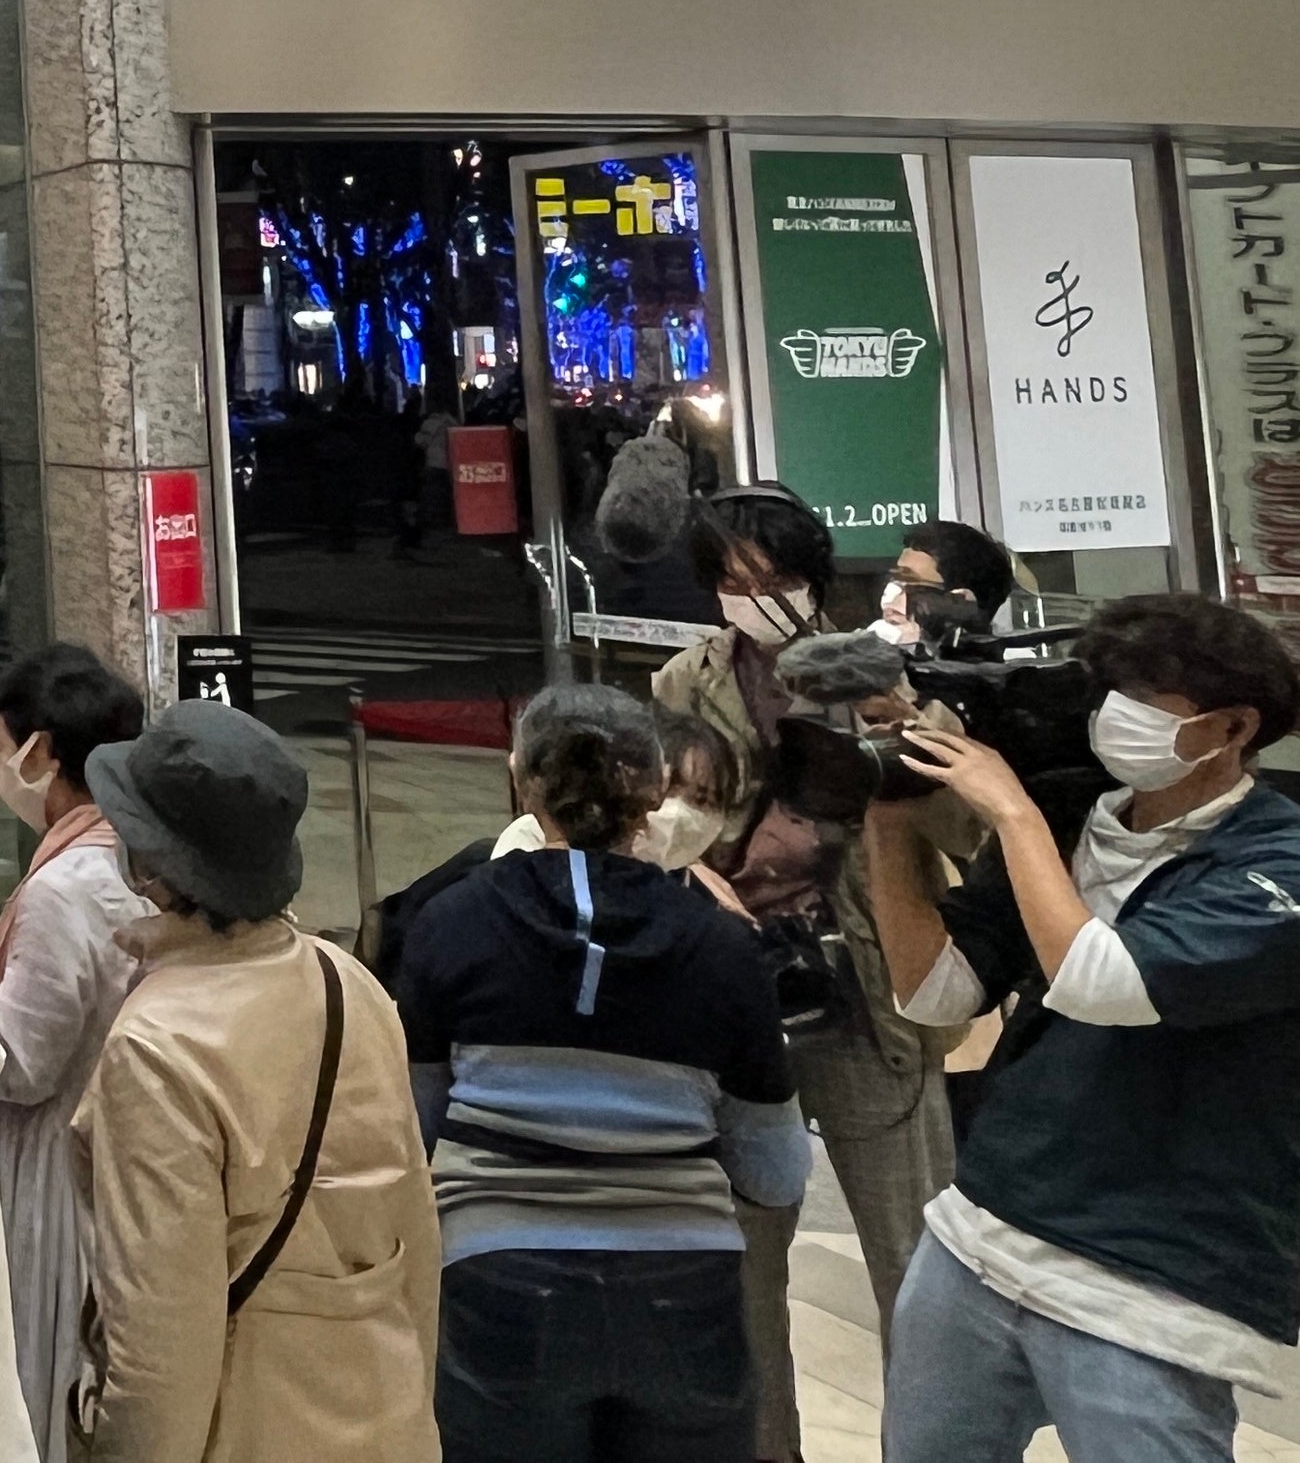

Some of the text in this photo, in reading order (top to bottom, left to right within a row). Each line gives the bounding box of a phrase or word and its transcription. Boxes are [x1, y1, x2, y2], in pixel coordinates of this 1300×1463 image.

[820, 336, 888, 356] TOKYU
[820, 357, 888, 377] HANDS
[1015, 376, 1129, 404] HANDS
